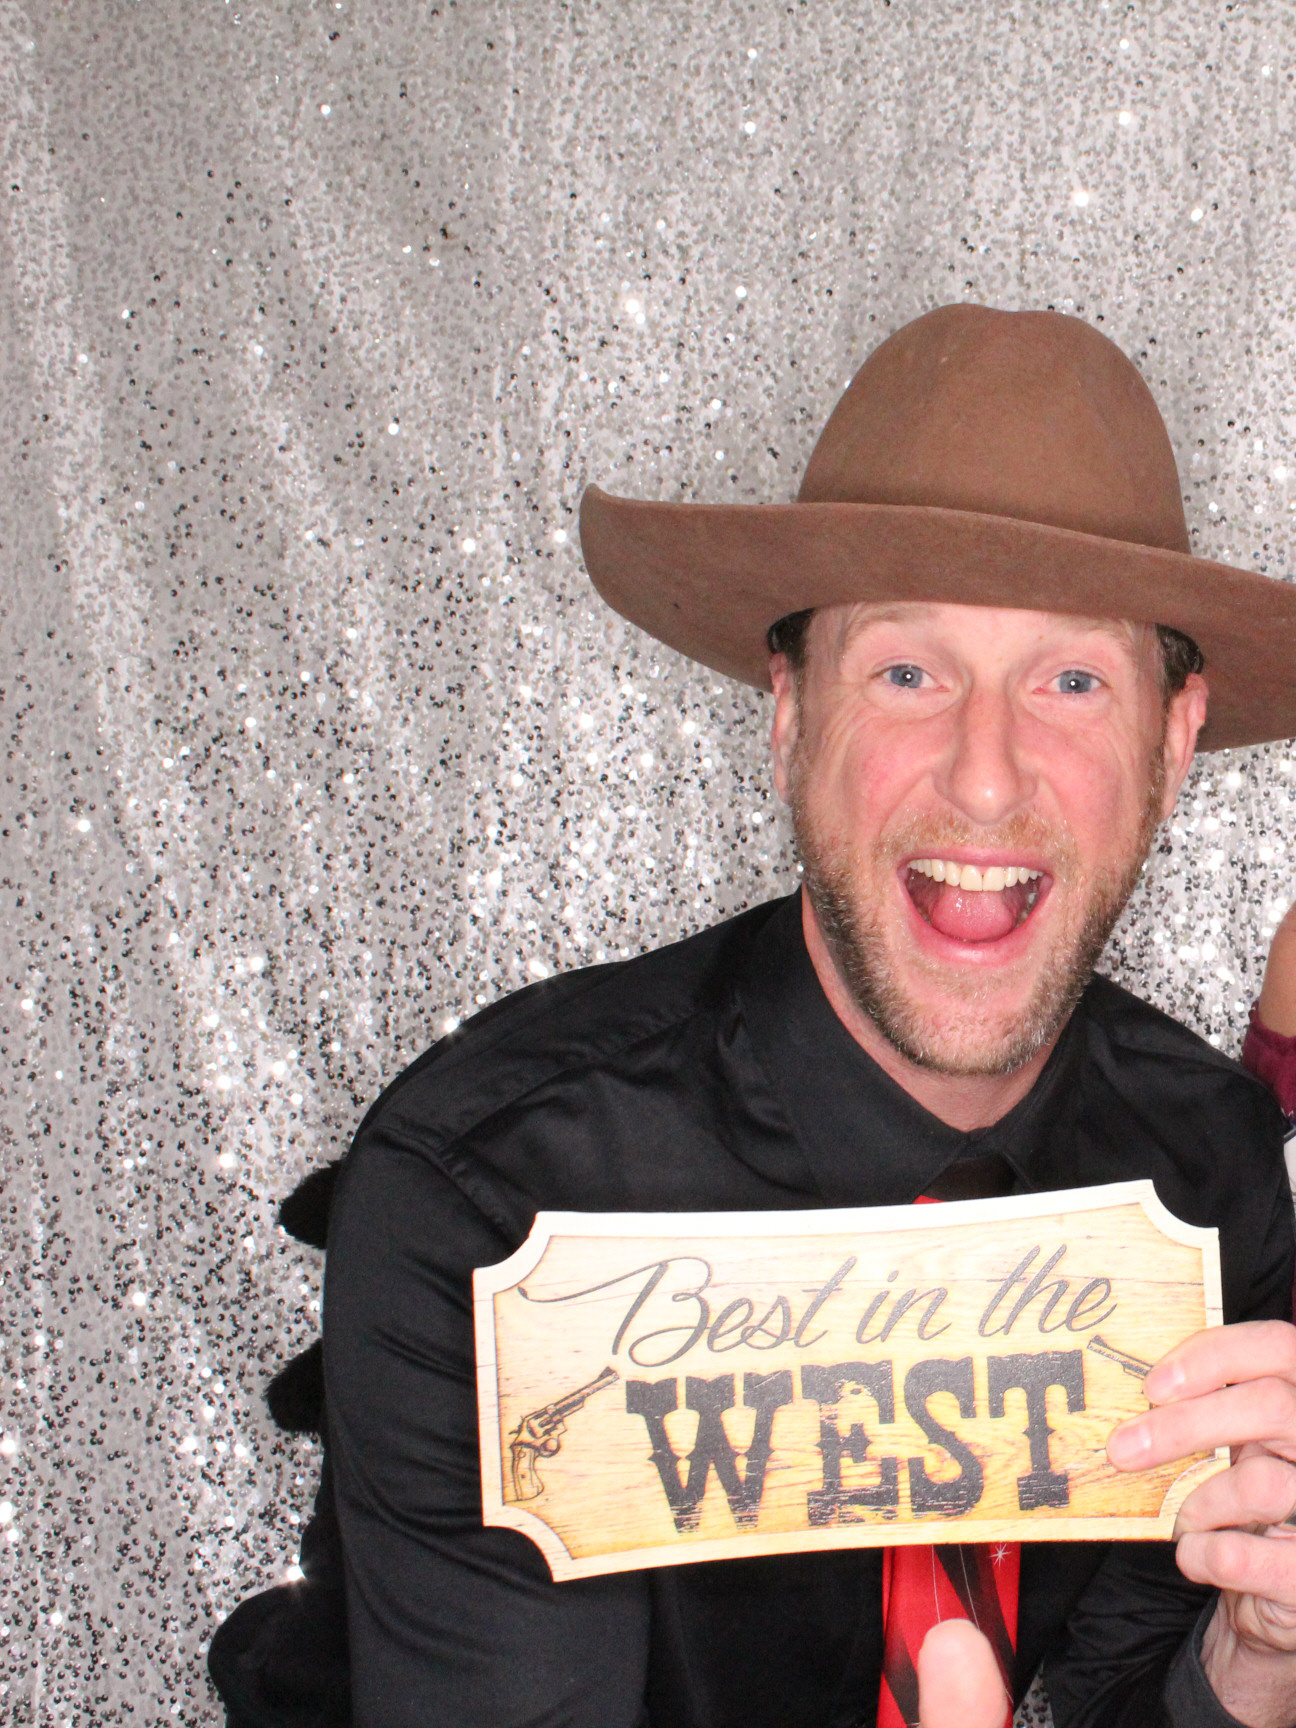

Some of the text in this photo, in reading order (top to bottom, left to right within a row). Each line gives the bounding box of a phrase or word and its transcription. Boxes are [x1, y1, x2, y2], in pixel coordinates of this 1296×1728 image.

[516, 1243, 1118, 1368] Best in the
[625, 1348, 1088, 1534] WEST
